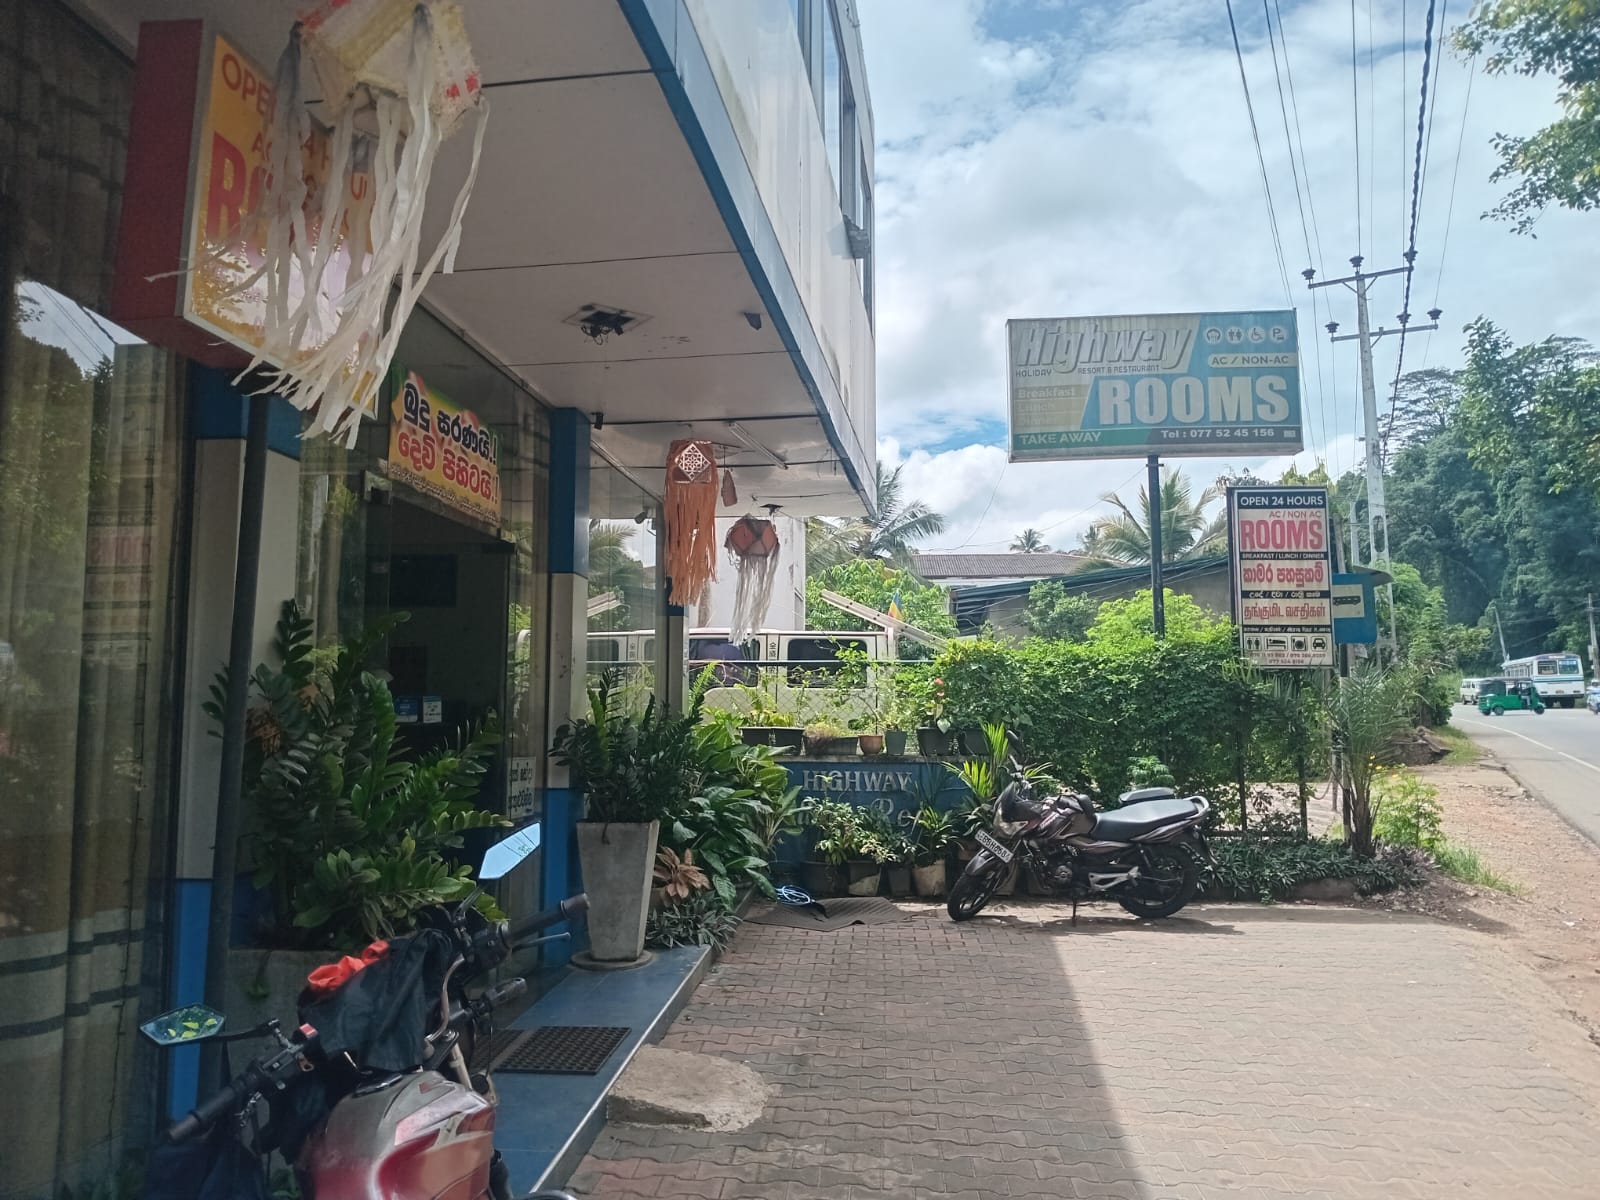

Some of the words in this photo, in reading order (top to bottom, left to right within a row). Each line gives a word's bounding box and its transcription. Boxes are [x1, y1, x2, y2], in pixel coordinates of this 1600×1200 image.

[1016, 323, 1192, 374] Highway
[1211, 356, 1228, 365] AC
[1241, 355, 1289, 365] NON-AC
[1016, 368, 1052, 377] HOLIDAY
[1078, 366, 1105, 375] RESORT
[1113, 364, 1160, 373] RESTAURANT
[1018, 387, 1076, 399] Breakfast
[1099, 375, 1289, 425] ROOMS
[1018, 433, 1057, 445] TAKE
[1059, 431, 1102, 444] AWAY
[1161, 429, 1179, 439] Tel
[1190, 429, 1212, 439] 077
[1215, 429, 1231, 438] 52
[1233, 429, 1249, 438] 45
[1252, 428, 1275, 438] 156
[1240, 496, 1269, 506] OPEN
[1272, 496, 1284, 506] 24
[1286, 495, 1324, 506] HOURS
[1269, 510, 1281, 518] AC
[1288, 510, 1307, 518] NON
[1309, 510, 1322, 518] AC
[1240, 519, 1323, 550] ROOMS
[802, 769, 913, 792] HIGHWAY
